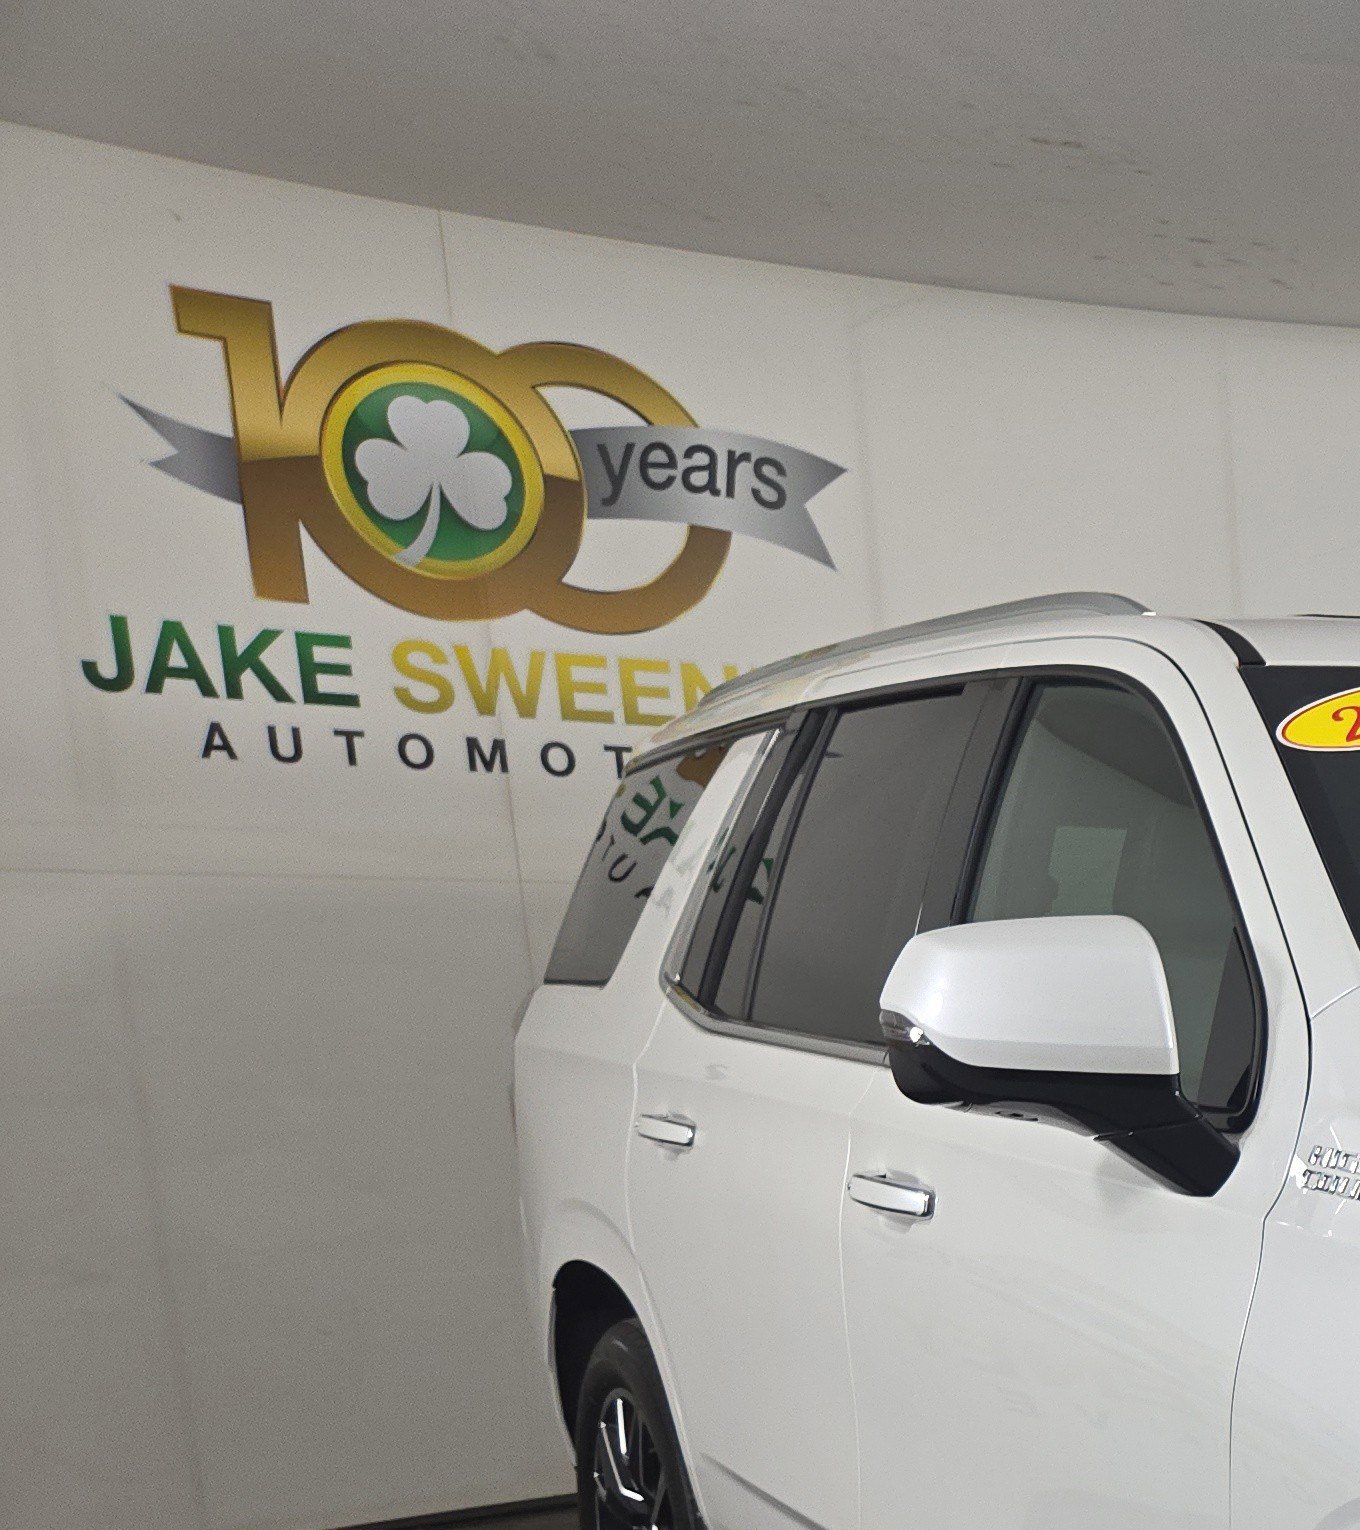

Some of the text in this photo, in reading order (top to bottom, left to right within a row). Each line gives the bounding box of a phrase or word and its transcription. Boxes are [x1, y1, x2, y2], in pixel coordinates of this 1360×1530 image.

[596, 432, 788, 510] years
[81, 614, 757, 727] JAKE SWEEN
[202, 722, 633, 780] AUTOMOT
